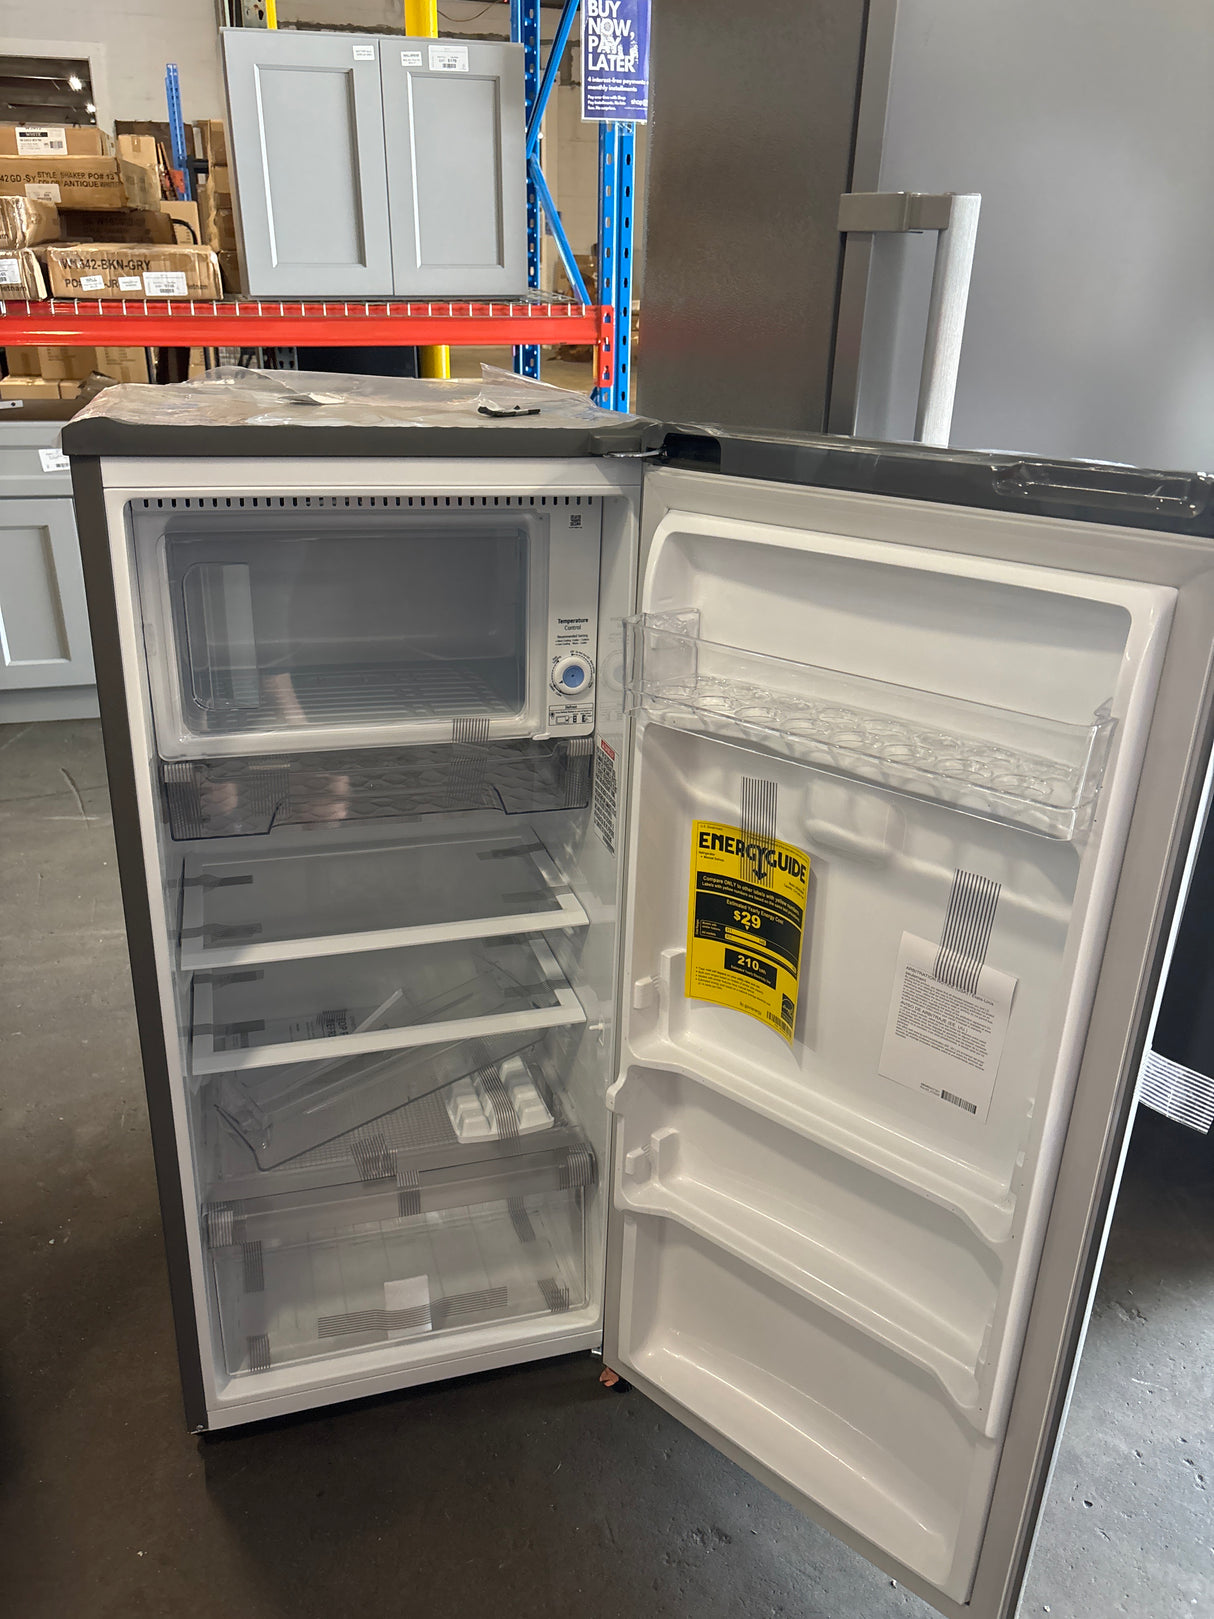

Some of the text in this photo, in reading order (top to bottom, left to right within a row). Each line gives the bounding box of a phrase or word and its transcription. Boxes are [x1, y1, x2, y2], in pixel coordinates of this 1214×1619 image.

[588, 0, 621, 18] BUY
[588, 17, 635, 40] NOW,
[588, 35, 621, 54] PAY
[588, 53, 636, 72] LATER
[702, 876, 723, 884] Compare
[726, 899, 748, 910] Estimated
[734, 910, 761, 929] $29
[737, 954, 759, 970] 210
